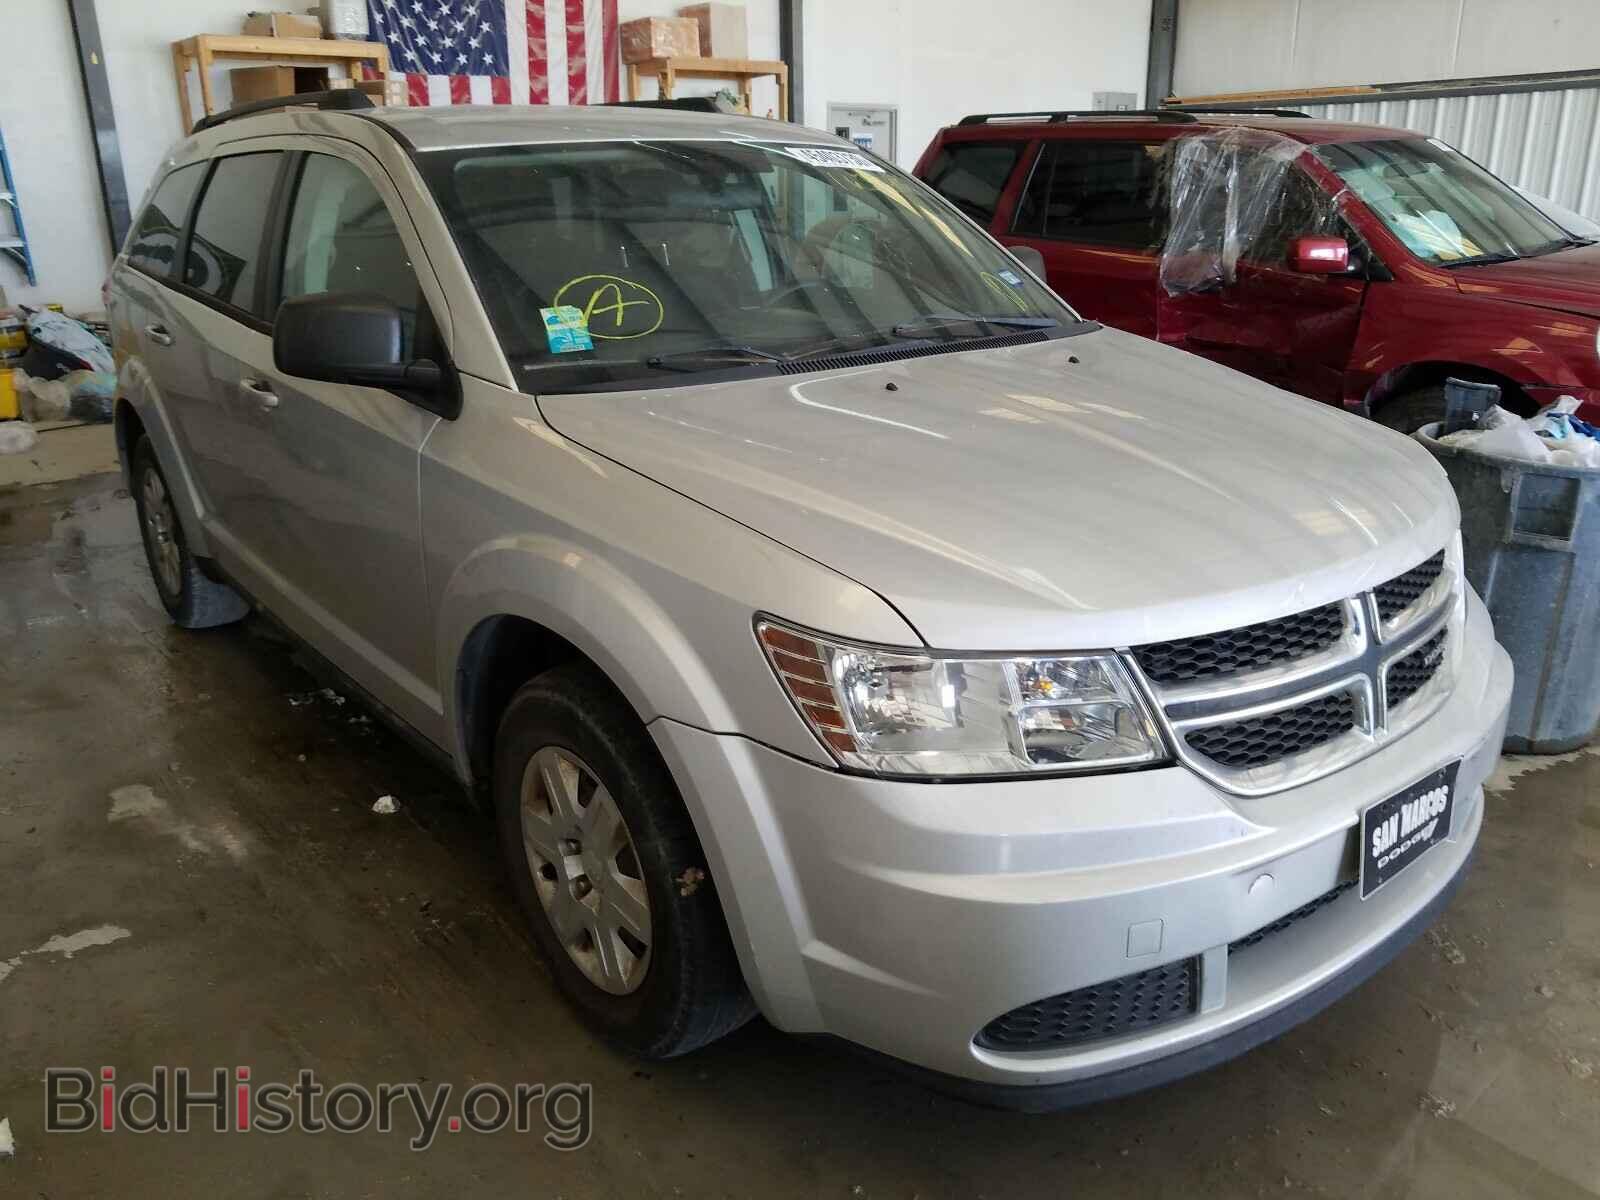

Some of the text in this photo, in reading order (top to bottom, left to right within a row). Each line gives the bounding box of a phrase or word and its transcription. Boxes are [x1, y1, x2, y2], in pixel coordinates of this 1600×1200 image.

[582, 283, 650, 326] A
[1372, 785, 1449, 857] SAN MARCOS
[1377, 818, 1439, 869] DODGE
